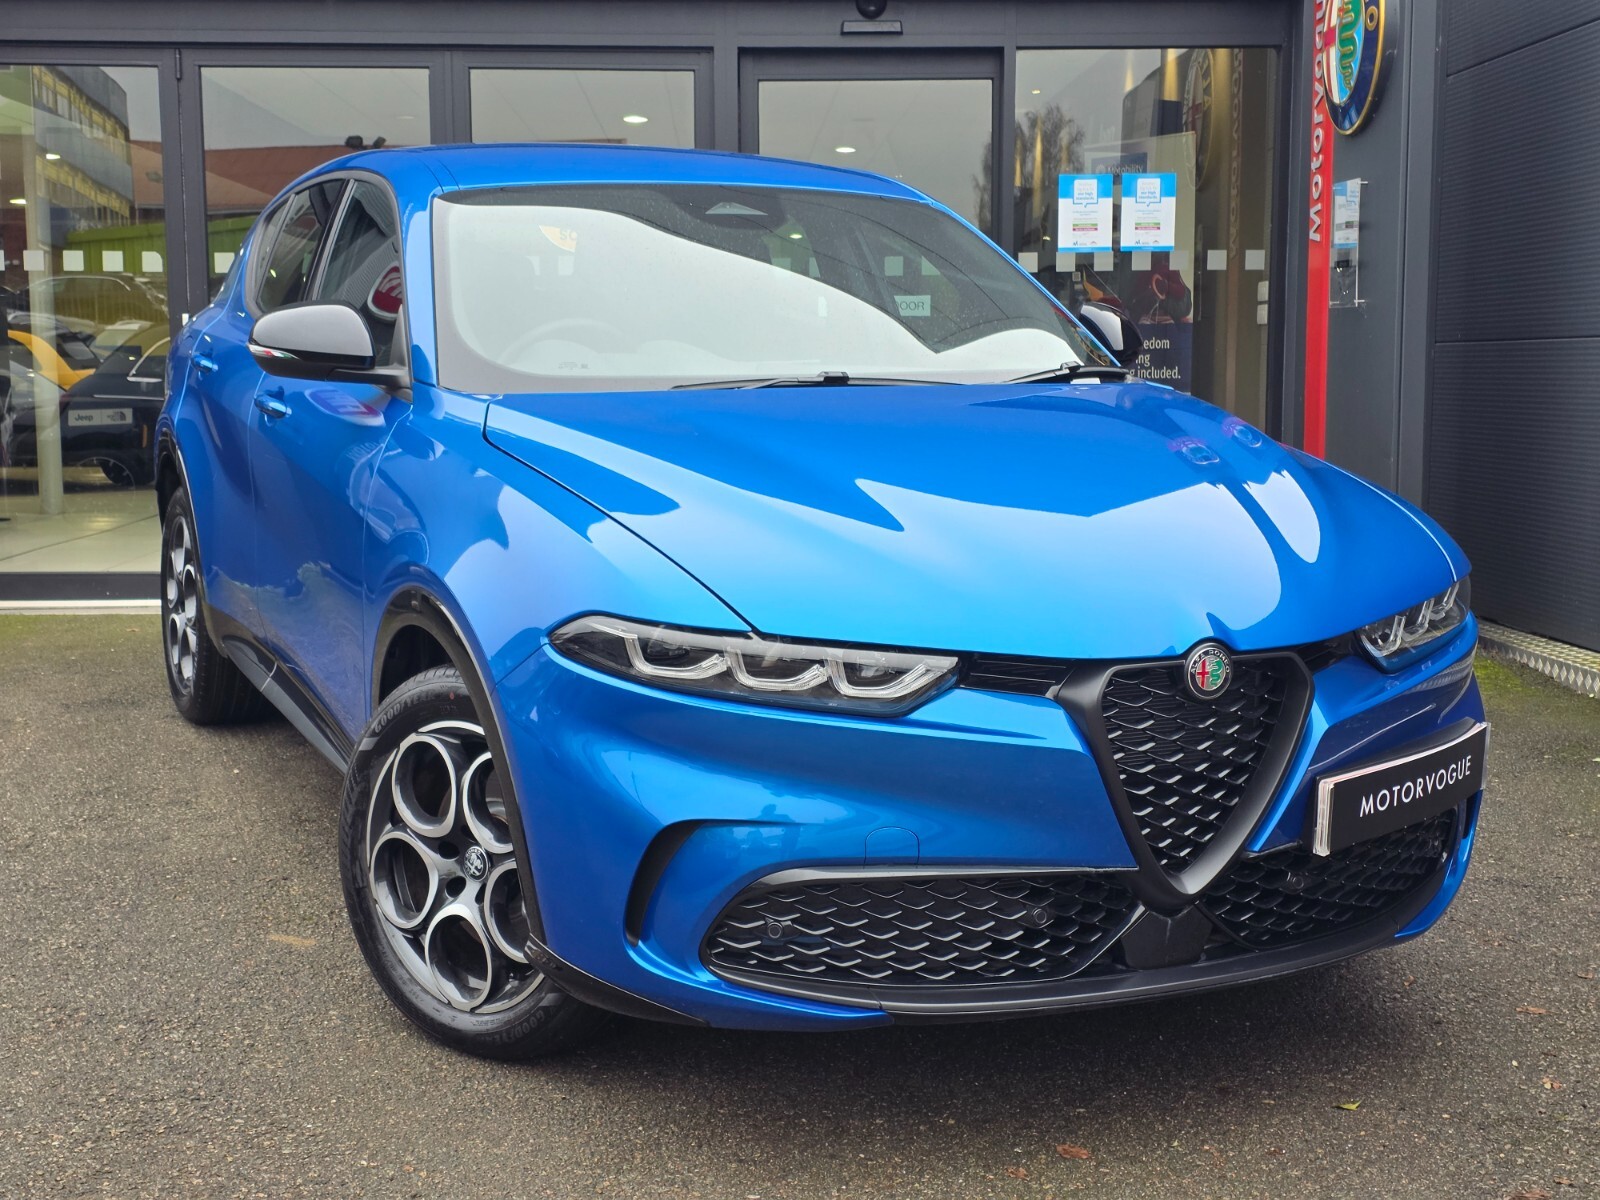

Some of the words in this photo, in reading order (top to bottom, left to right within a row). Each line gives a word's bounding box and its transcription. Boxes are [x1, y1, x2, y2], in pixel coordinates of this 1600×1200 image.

[1143, 336, 1170, 349] edom
[1137, 366, 1181, 379] included.
[74, 412, 94, 422] Jeep
[1190, 653, 1206, 674] ALFA
[1208, 649, 1230, 673] ROMEO
[1359, 754, 1472, 818] MOTORVOGUE
